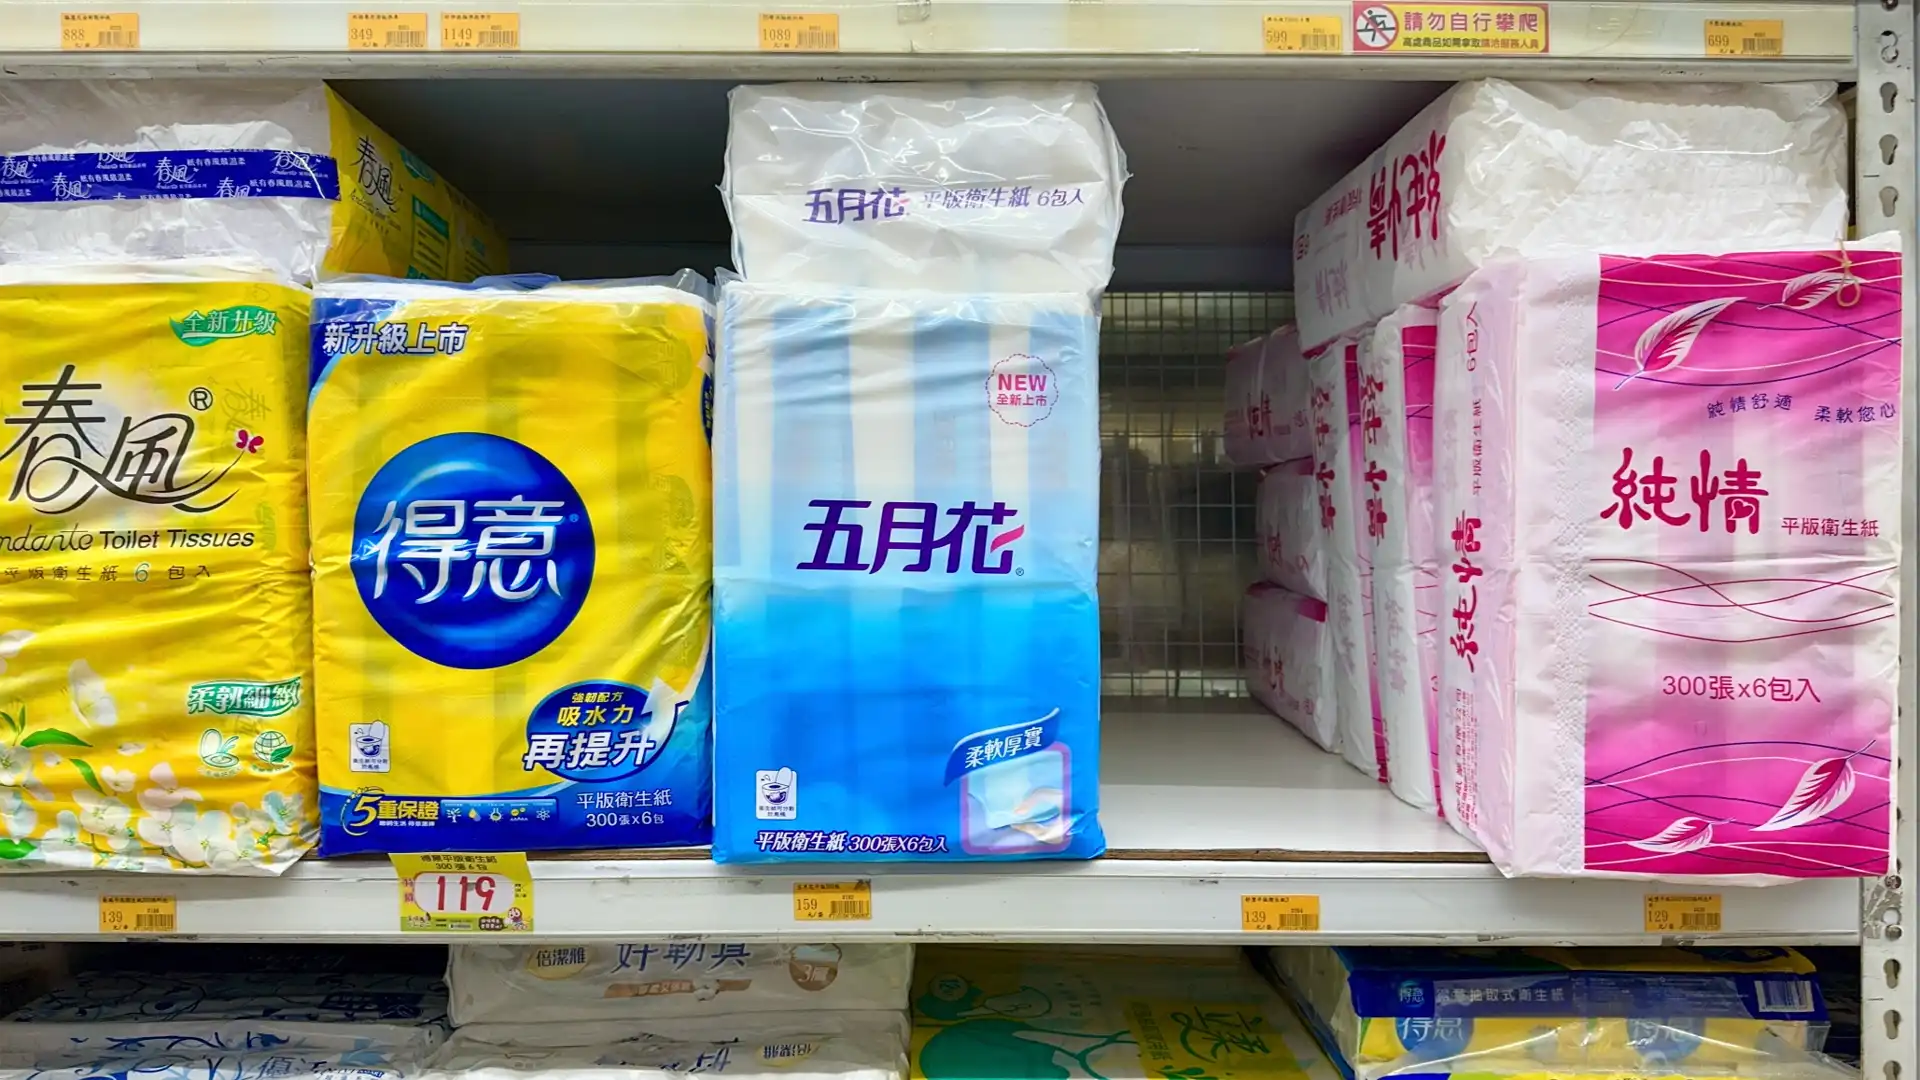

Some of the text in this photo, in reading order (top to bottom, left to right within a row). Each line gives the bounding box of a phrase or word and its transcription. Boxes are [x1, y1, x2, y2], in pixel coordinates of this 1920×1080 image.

[1403, 12, 1539, 33] 請勿自行攀爬
[63, 28, 85, 41] 888
[350, 28, 373, 40] 349
[443, 28, 473, 40] 1149
[762, 28, 791, 41] 1089
[1265, 32, 1288, 43] 599
[1708, 34, 1730, 47] 699
[153, 156, 196, 184] 春風
[51, 172, 92, 199] 春風
[802, 186, 1086, 225] 五月花 平版衛生紙 6包入
[182, 309, 278, 335] 全新升級
[322, 321, 469, 356] 新升級上市
[998, 373, 1047, 392] NEW
[996, 393, 1048, 407] 全新上市
[1706, 392, 1793, 420] 純情舒適
[1813, 402, 1897, 424] 柔軟您心
[0, 364, 241, 514] 春風
[1599, 447, 1770, 535] 純情
[796, 499, 1026, 576] 五月花
[1780, 516, 1881, 538] 平版衛生紙
[101, 530, 160, 549] Toilet
[167, 529, 255, 548] Tissues
[372, 494, 567, 606] 得意
[4, 565, 119, 583] 平版衛生紙
[134, 562, 150, 583] 6
[571, 691, 625, 704] 強韌配方
[1661, 675, 1822, 703] 300張x6包入
[557, 703, 635, 728] 吸水力
[522, 730, 656, 771] 再提升
[964, 726, 1044, 769] 柔軟厚實
[576, 788, 673, 810] 平版衛生紙
[349, 795, 440, 828] 5重保證
[586, 811, 665, 828] 300張x6包
[755, 830, 949, 853] 平版衛生紙 300張X6包入
[436, 875, 497, 911] 119
[796, 898, 818, 911] 159
[102, 910, 123, 923] 139
[1244, 910, 1267, 923] 139
[1648, 910, 1668, 922] 129
[536, 947, 587, 968] 倍潔雅
